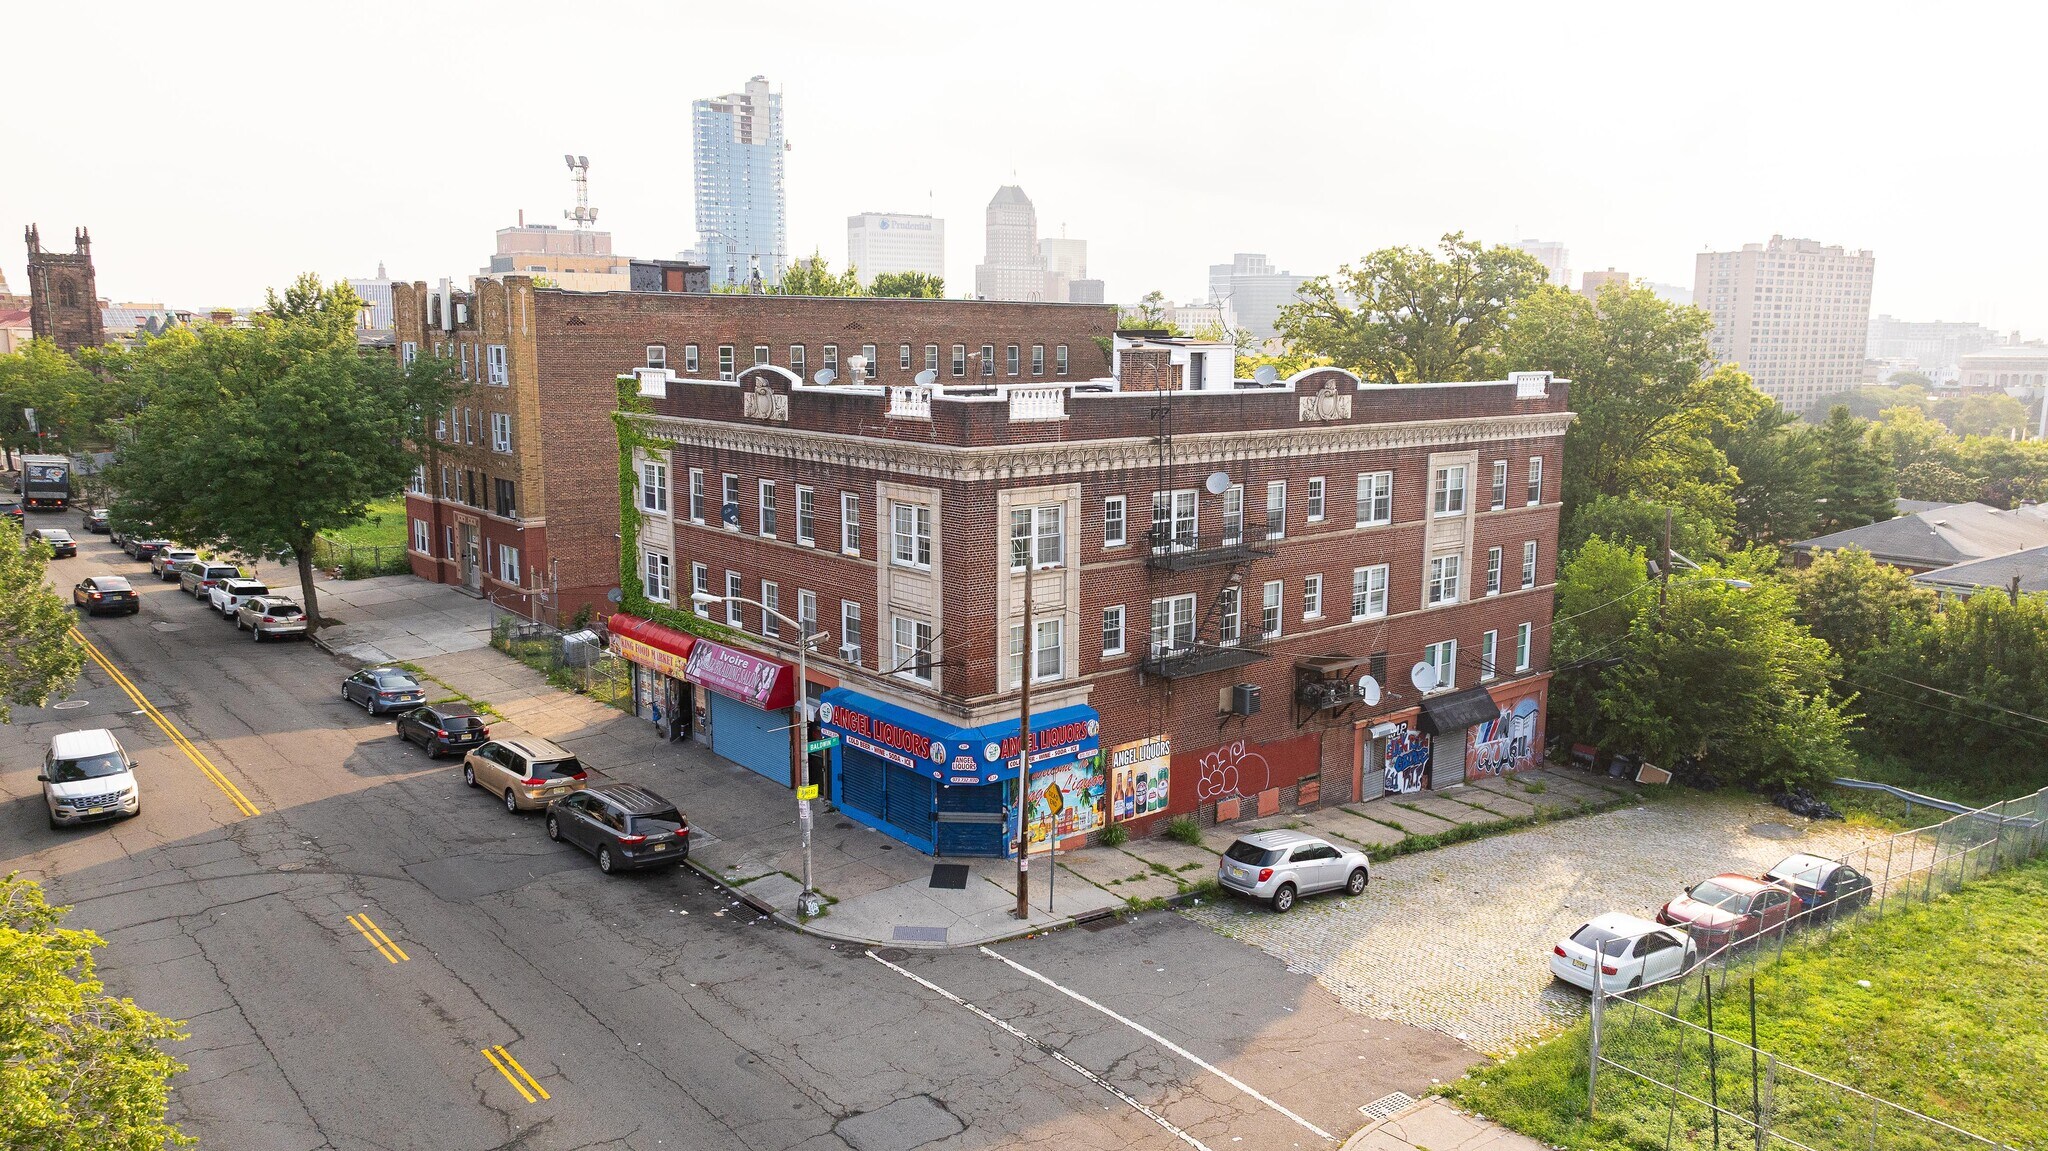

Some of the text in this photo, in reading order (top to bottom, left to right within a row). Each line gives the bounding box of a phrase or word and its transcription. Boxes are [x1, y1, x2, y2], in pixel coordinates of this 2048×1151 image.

[891, 221, 932, 231] Prudential
[635, 643, 650, 657] FOOD
[651, 649, 673, 666] MARKET
[720, 650, 749, 669] Ivoire
[831, 705, 931, 760] ANGEL LIQUORS
[810, 740, 831, 751] BALDWIN
[1001, 721, 1088, 760] ANEL LIQUORS
[848, 736, 912, 767] COLD BEER WINE SODA ICE
[1054, 748, 1067, 756] SODA
[1113, 748, 1138, 768] ANGEL
[1139, 741, 1170, 762] LIQUORS
[952, 763, 977, 771] LIQUORS
[1048, 790, 1059, 801] DEAD
[1049, 799, 1057, 808] END
